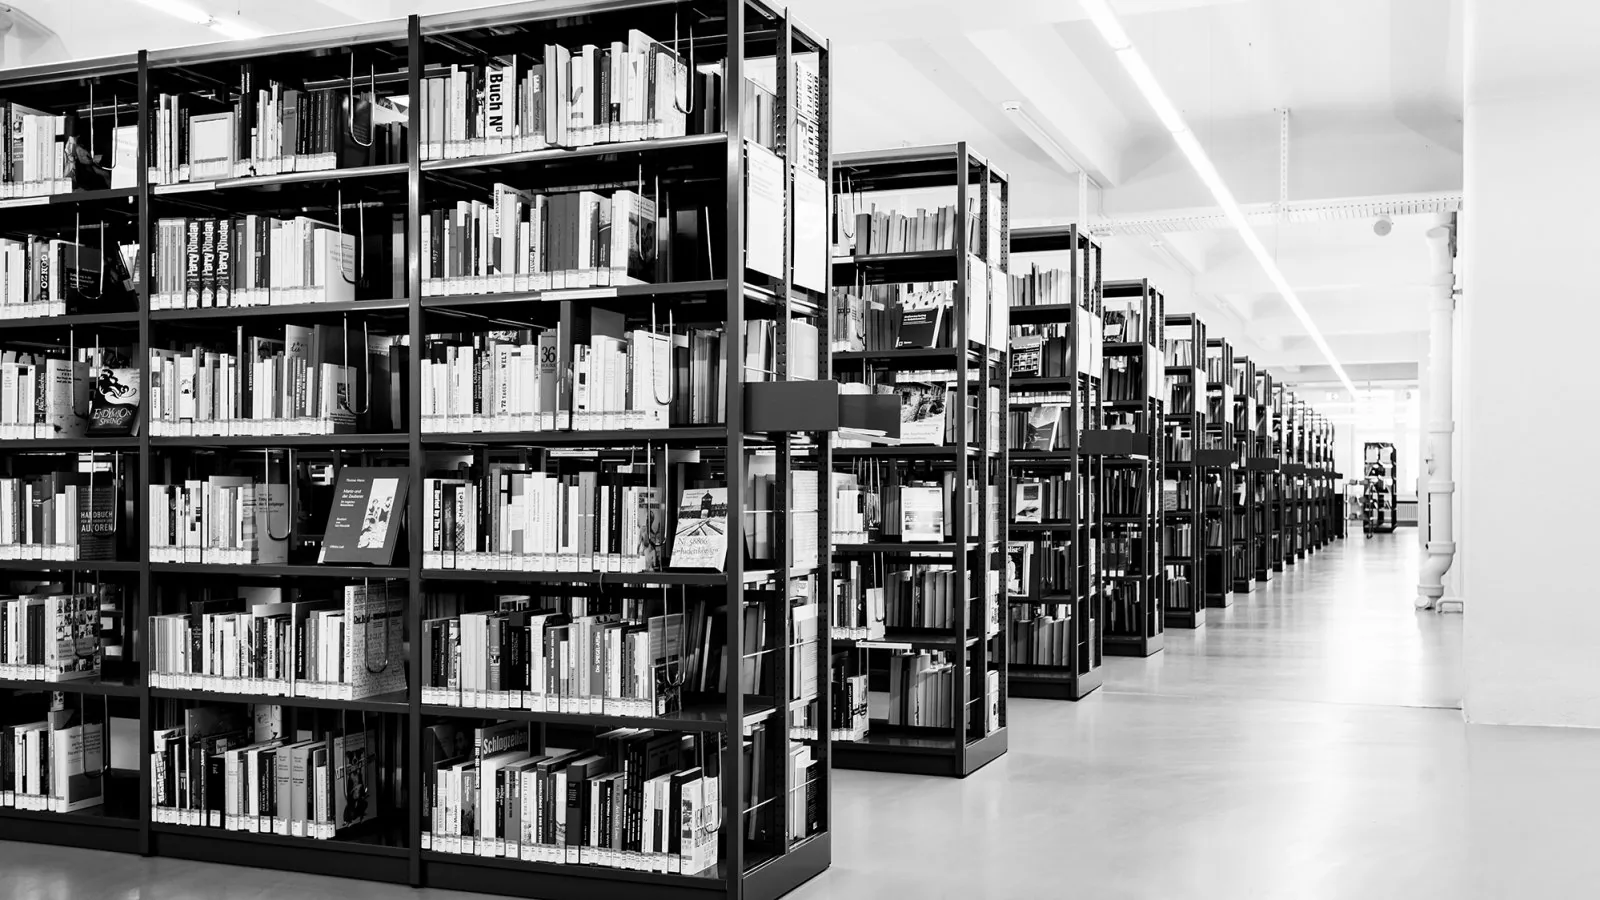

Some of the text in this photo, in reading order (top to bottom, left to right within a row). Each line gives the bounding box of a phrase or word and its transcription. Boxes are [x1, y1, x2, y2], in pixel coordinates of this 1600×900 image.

[489, 73, 503, 111] Buch
[187, 222, 200, 277] Perry Rhodan
[202, 221, 214, 276] Perry Rhodan
[216, 220, 229, 275] Perry Rhodan
[41, 254, 49, 289] GONZO
[541, 346, 556, 363] 36
[93, 408, 132, 420] ENDYMION
[99, 418, 122, 426] SPRING
[80, 524, 113, 533] AUOREN
